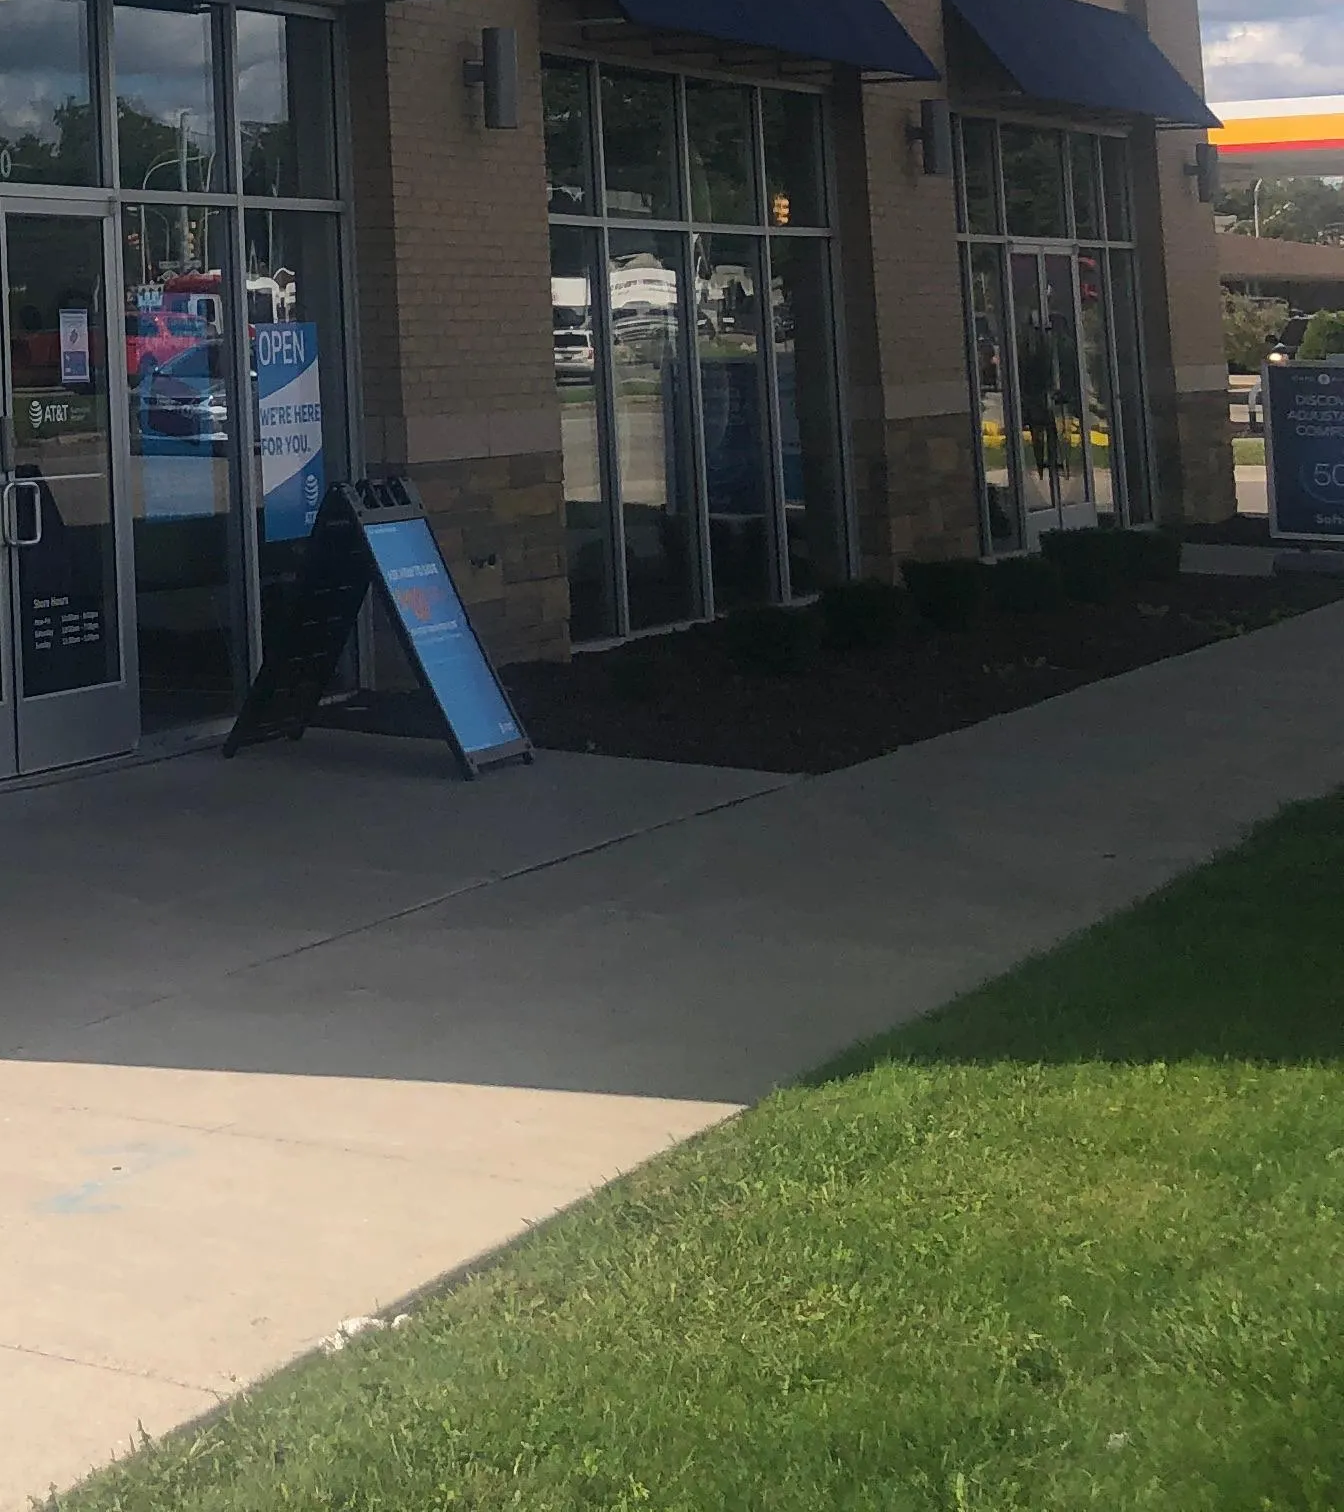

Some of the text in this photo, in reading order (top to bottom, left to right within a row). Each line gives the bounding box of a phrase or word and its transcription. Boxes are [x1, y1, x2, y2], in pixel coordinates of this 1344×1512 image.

[259, 330, 305, 366] OPEN
[44, 405, 68, 422] AT&T
[261, 403, 320, 426] WE'RE HERE
[262, 434, 311, 456] FOR YOU.
